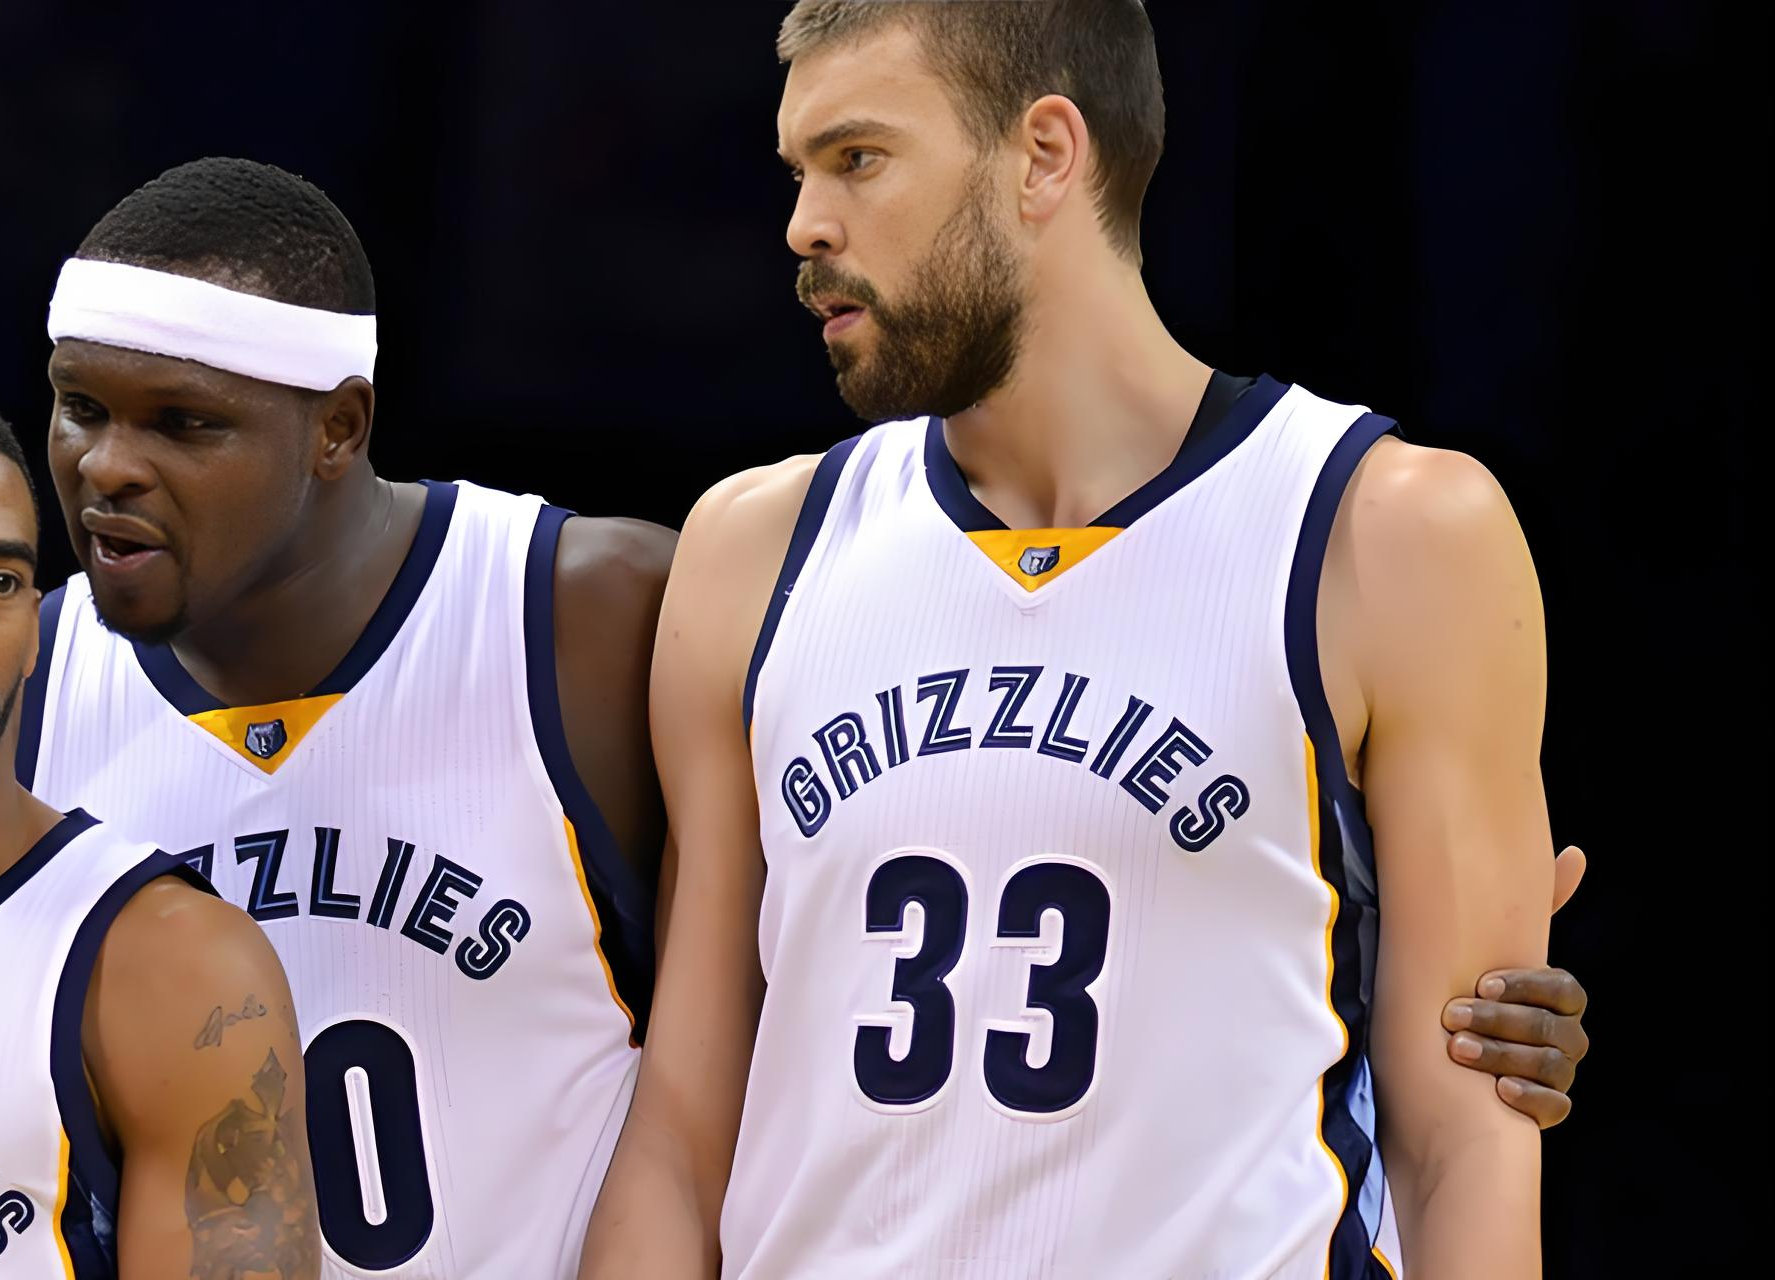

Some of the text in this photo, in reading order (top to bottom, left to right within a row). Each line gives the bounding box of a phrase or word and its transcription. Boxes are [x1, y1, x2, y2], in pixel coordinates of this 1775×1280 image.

[782, 665, 1251, 853] GRIZZLIES
[171, 826, 532, 981] ZLIES
[853, 855, 1112, 1114] 33
[303, 1018, 435, 1271] 0
